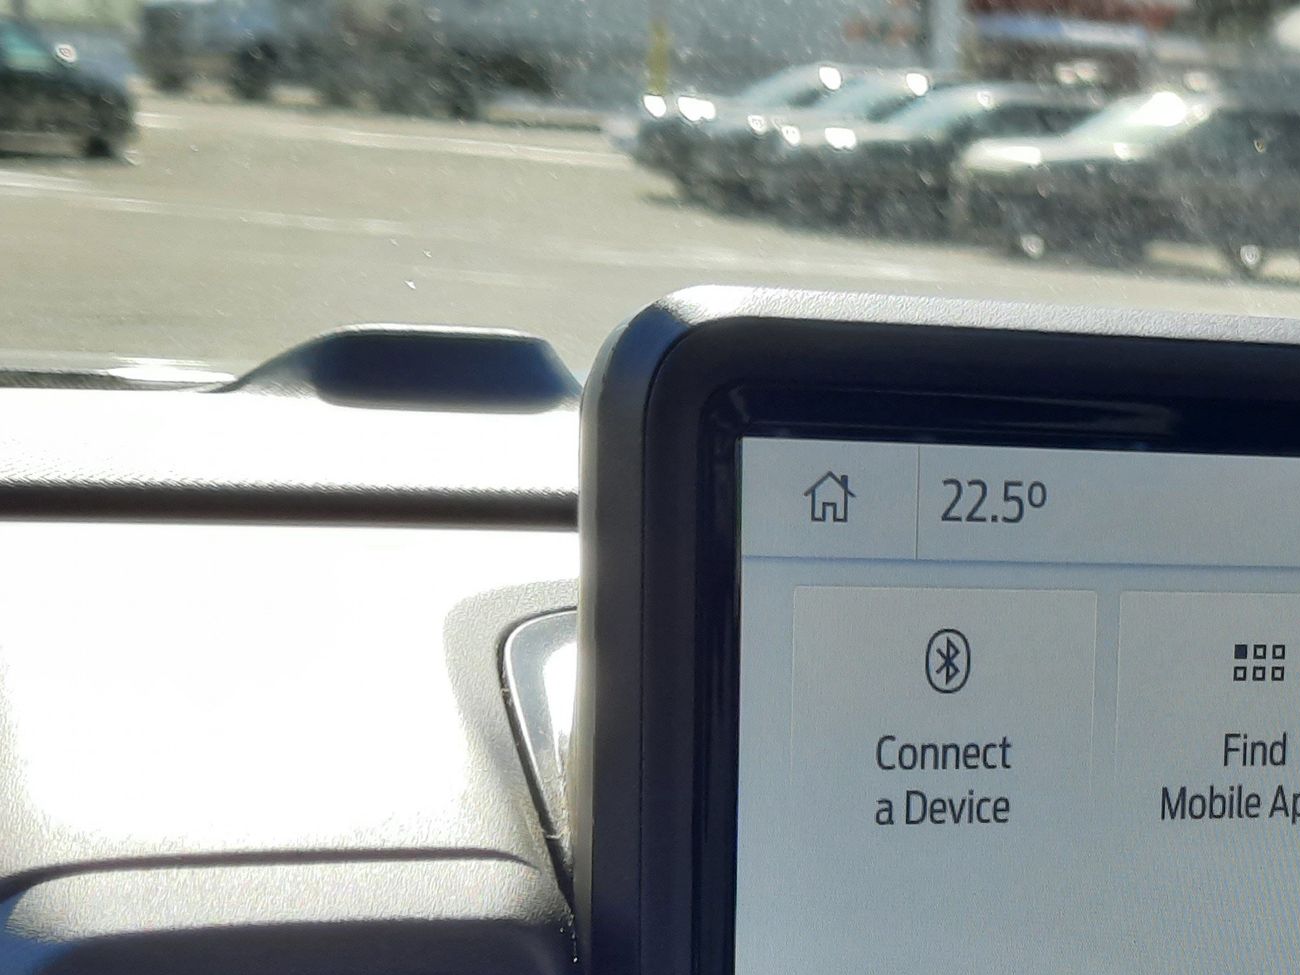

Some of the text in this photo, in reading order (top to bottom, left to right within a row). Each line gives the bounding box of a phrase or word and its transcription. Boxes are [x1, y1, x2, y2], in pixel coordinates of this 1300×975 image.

[875, 735, 1012, 771] Connect
[1222, 731, 1288, 767] Find
[875, 789, 1010, 826] a Device
[1161, 785, 1262, 821] Mobile
